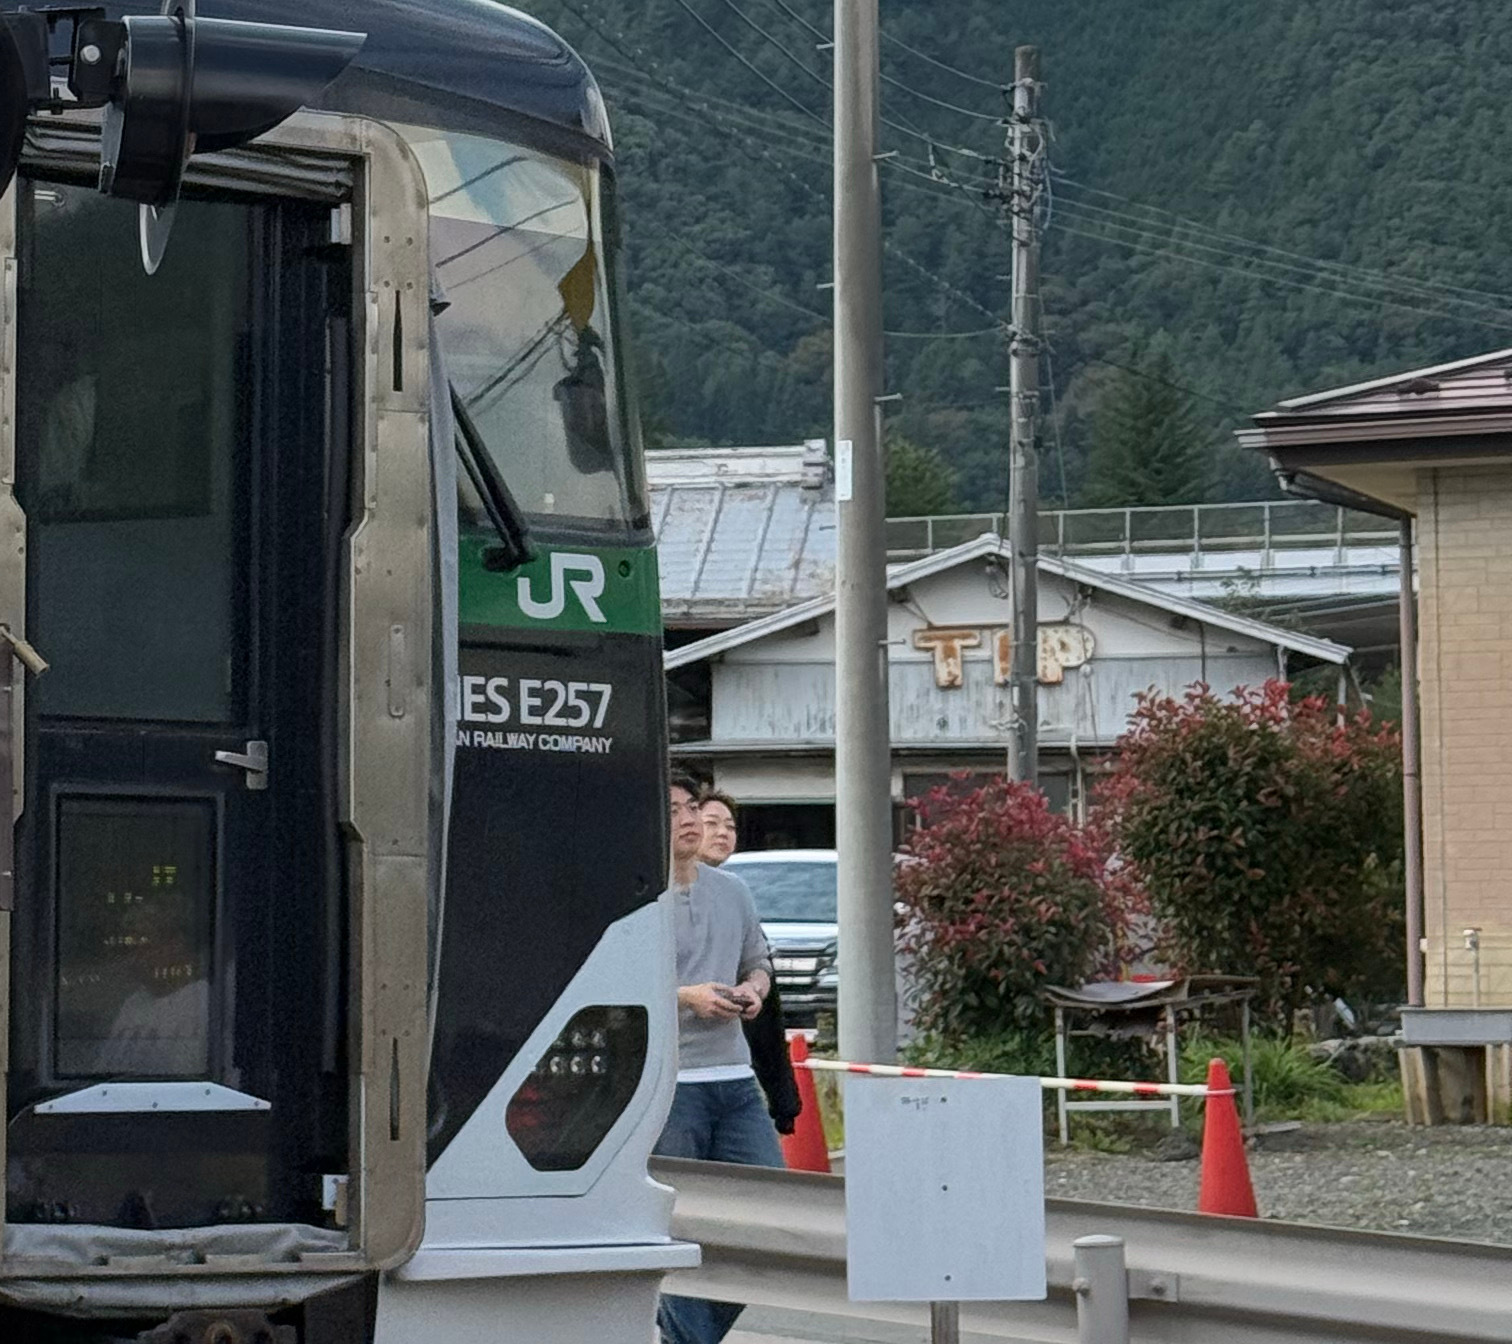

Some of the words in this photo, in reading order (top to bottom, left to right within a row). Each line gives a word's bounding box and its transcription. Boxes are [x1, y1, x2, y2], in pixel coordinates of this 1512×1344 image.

[517, 552, 607, 623] JR
[519, 679, 612, 728] E257
[473, 730, 537, 750] RAILWAY
[538, 734, 613, 754] COMPANY
